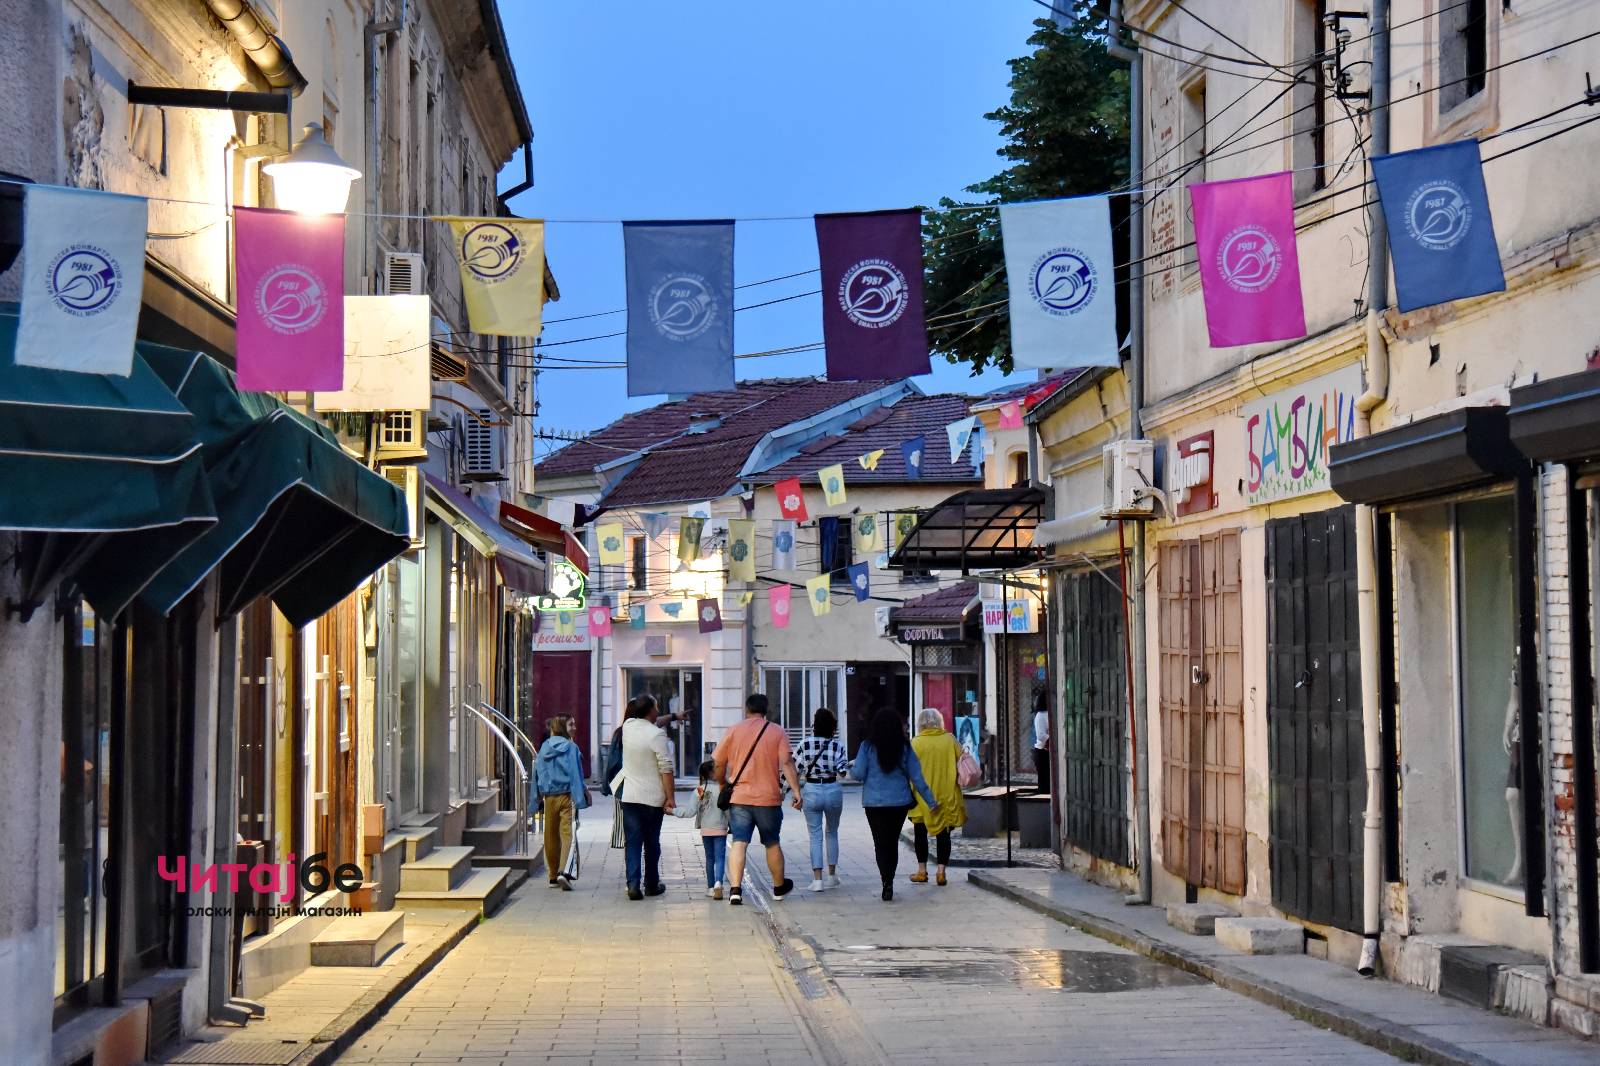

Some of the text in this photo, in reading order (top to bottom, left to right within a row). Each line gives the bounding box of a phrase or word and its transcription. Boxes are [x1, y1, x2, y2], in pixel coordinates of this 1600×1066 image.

[1425, 198, 1446, 209] 1981
[477, 233, 499, 243] 1981
[71, 261, 95, 272] 1981
[1050, 264, 1071, 274] 1981
[861, 274, 884, 286] 1981
[670, 288, 691, 298] 1981
